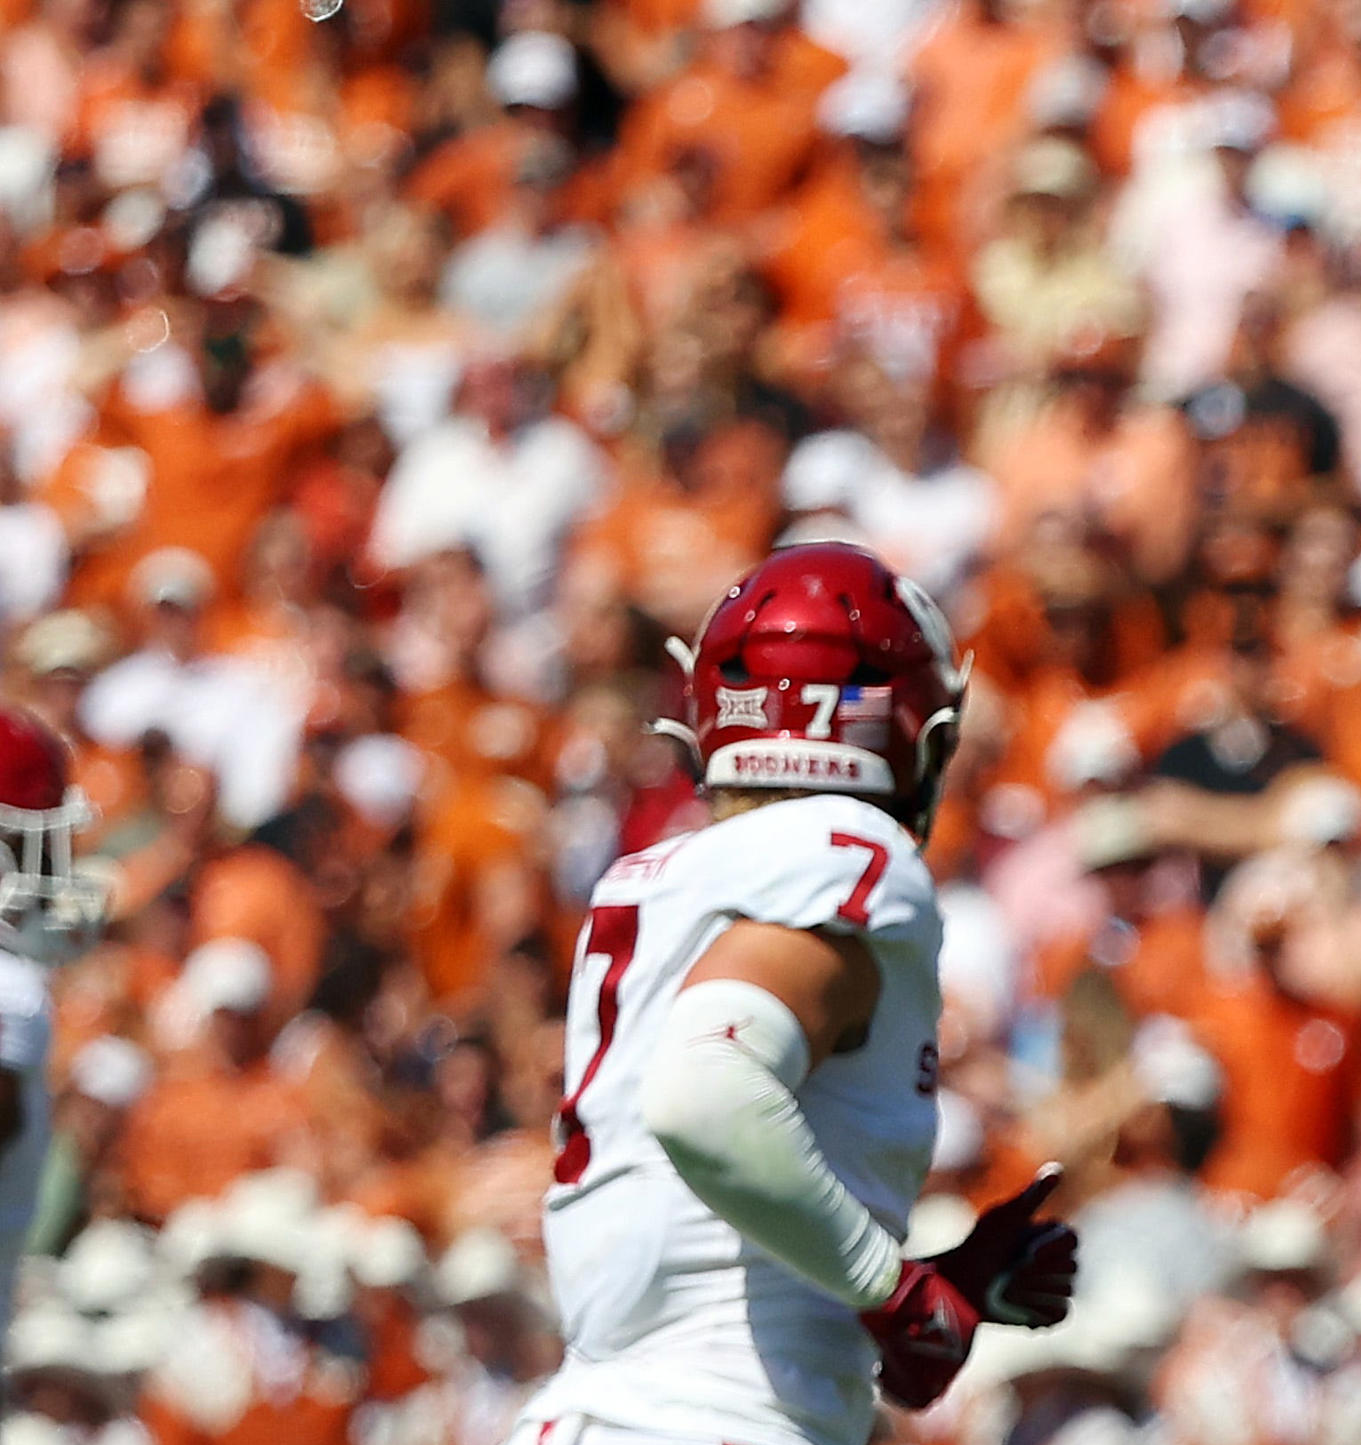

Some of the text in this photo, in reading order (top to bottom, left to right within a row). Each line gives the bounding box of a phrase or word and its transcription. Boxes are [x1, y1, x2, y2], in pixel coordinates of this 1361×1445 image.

[801, 684, 840, 740] 7
[734, 754, 862, 778] SOONERS
[829, 832, 890, 926] 7
